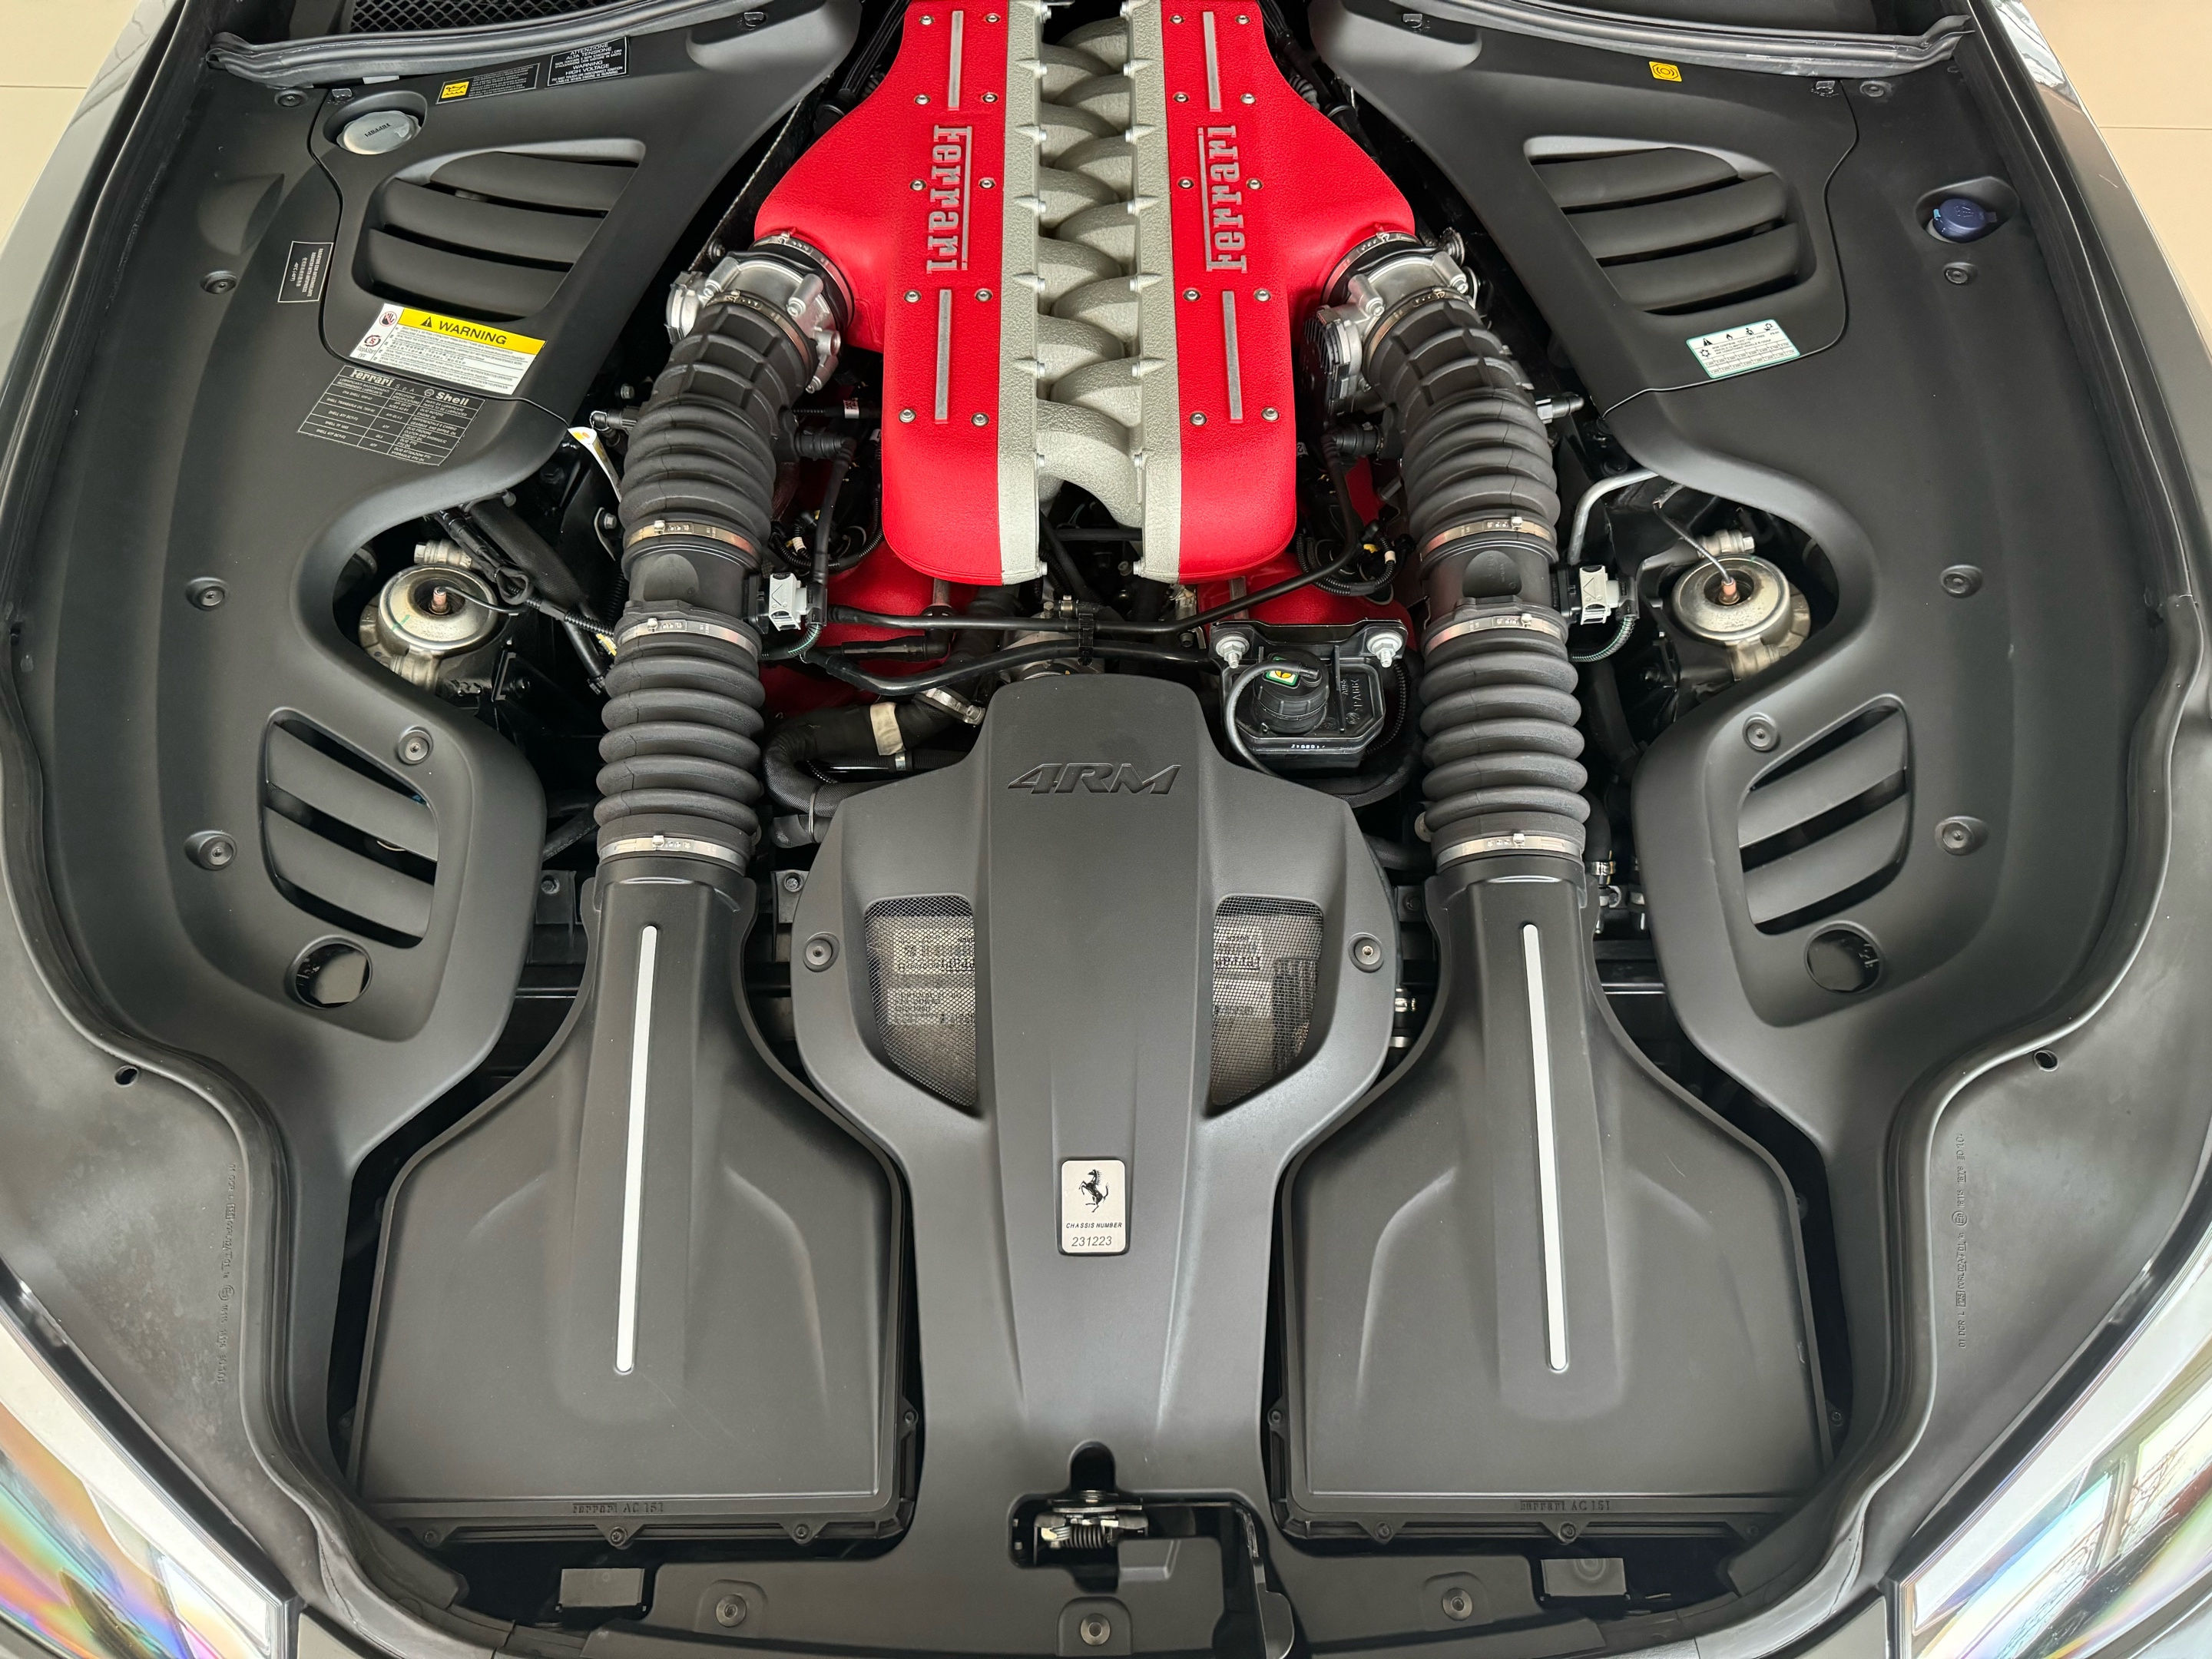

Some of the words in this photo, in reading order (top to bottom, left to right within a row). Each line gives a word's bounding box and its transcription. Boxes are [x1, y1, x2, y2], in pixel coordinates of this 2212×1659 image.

[570, 43, 608, 55] ATTENZIONE
[581, 46, 611, 57] TENSIONE
[572, 60, 602, 69] WARNING
[582, 63, 609, 72] VOLTAGE
[926, 124, 972, 274] Ferrari
[1197, 124, 1247, 274] Ferrari
[435, 320, 508, 345] WARNING
[349, 369, 395, 386] Ferrari
[434, 391, 469, 406] Shell
[1008, 763, 1181, 795] 4RM
[1071, 1236, 1112, 1247] 231223
[1571, 1500, 1588, 1512] AC
